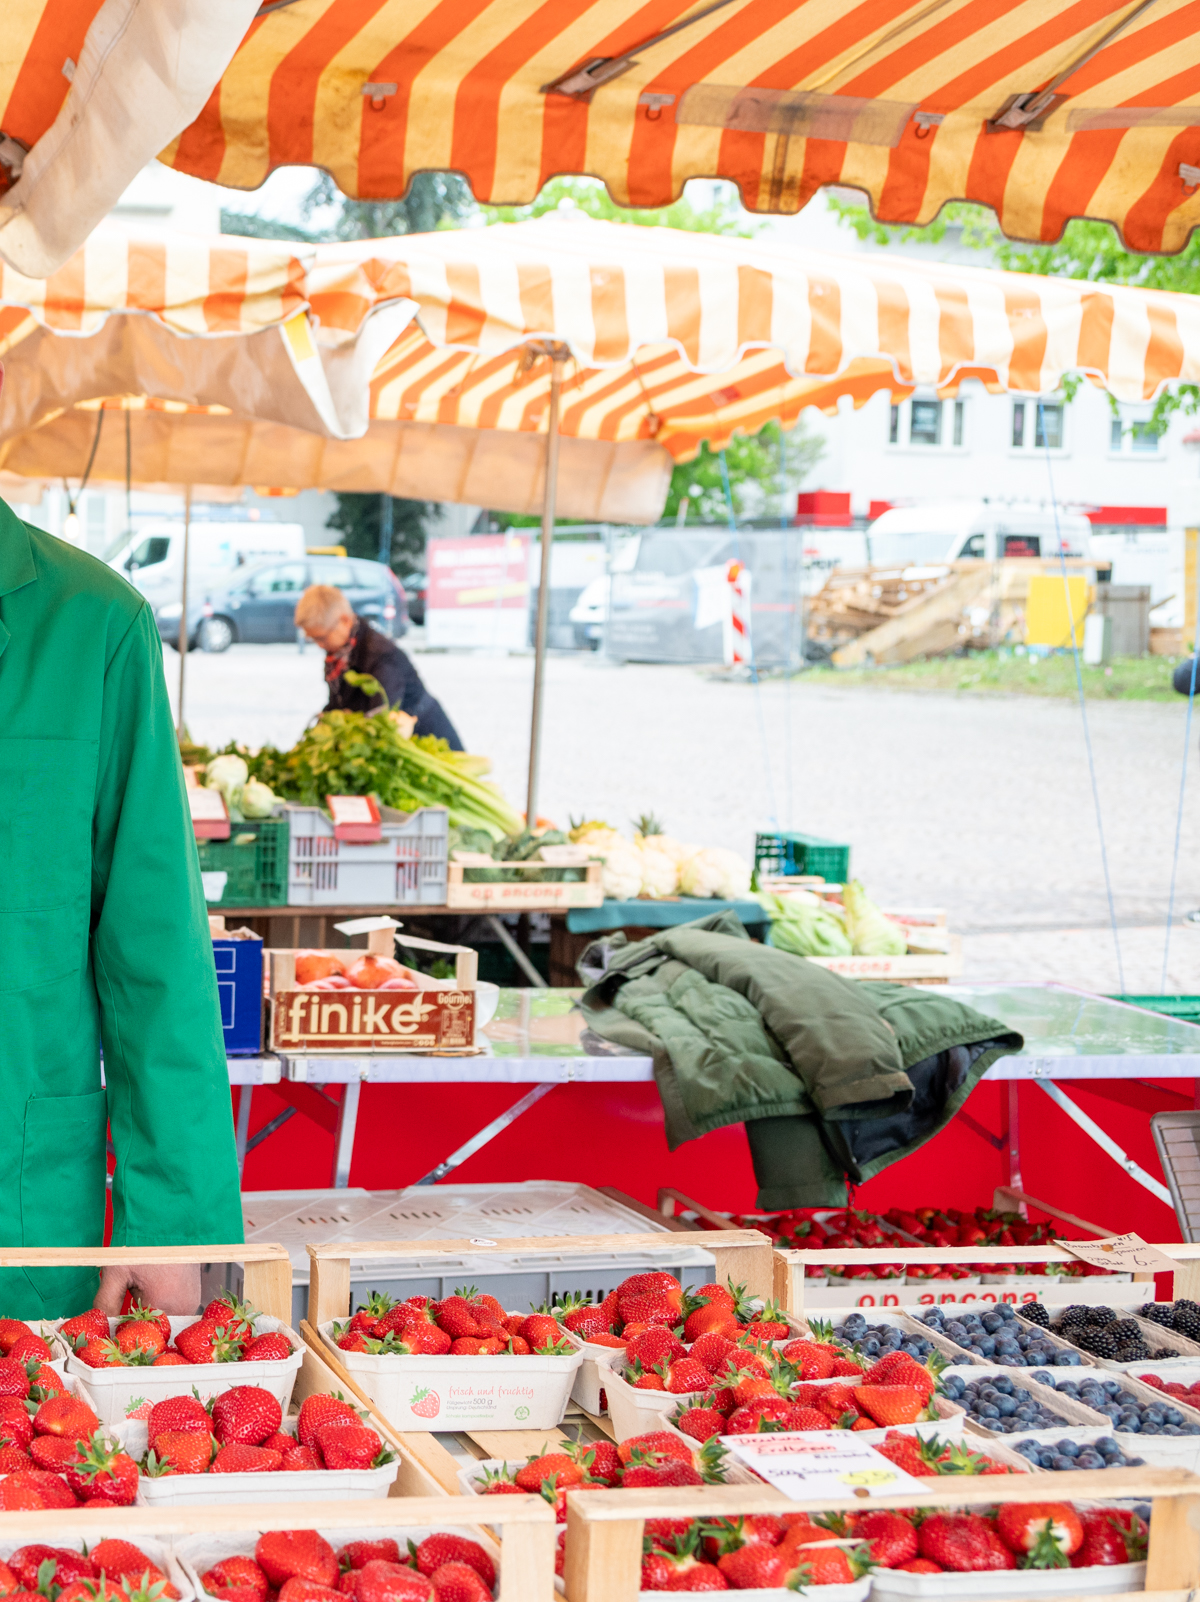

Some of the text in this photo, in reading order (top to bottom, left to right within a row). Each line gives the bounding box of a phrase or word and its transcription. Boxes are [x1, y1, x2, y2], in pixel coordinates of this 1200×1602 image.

[288, 994, 421, 1042] finike
[449, 1386, 534, 1399] frisch und fruchtig
